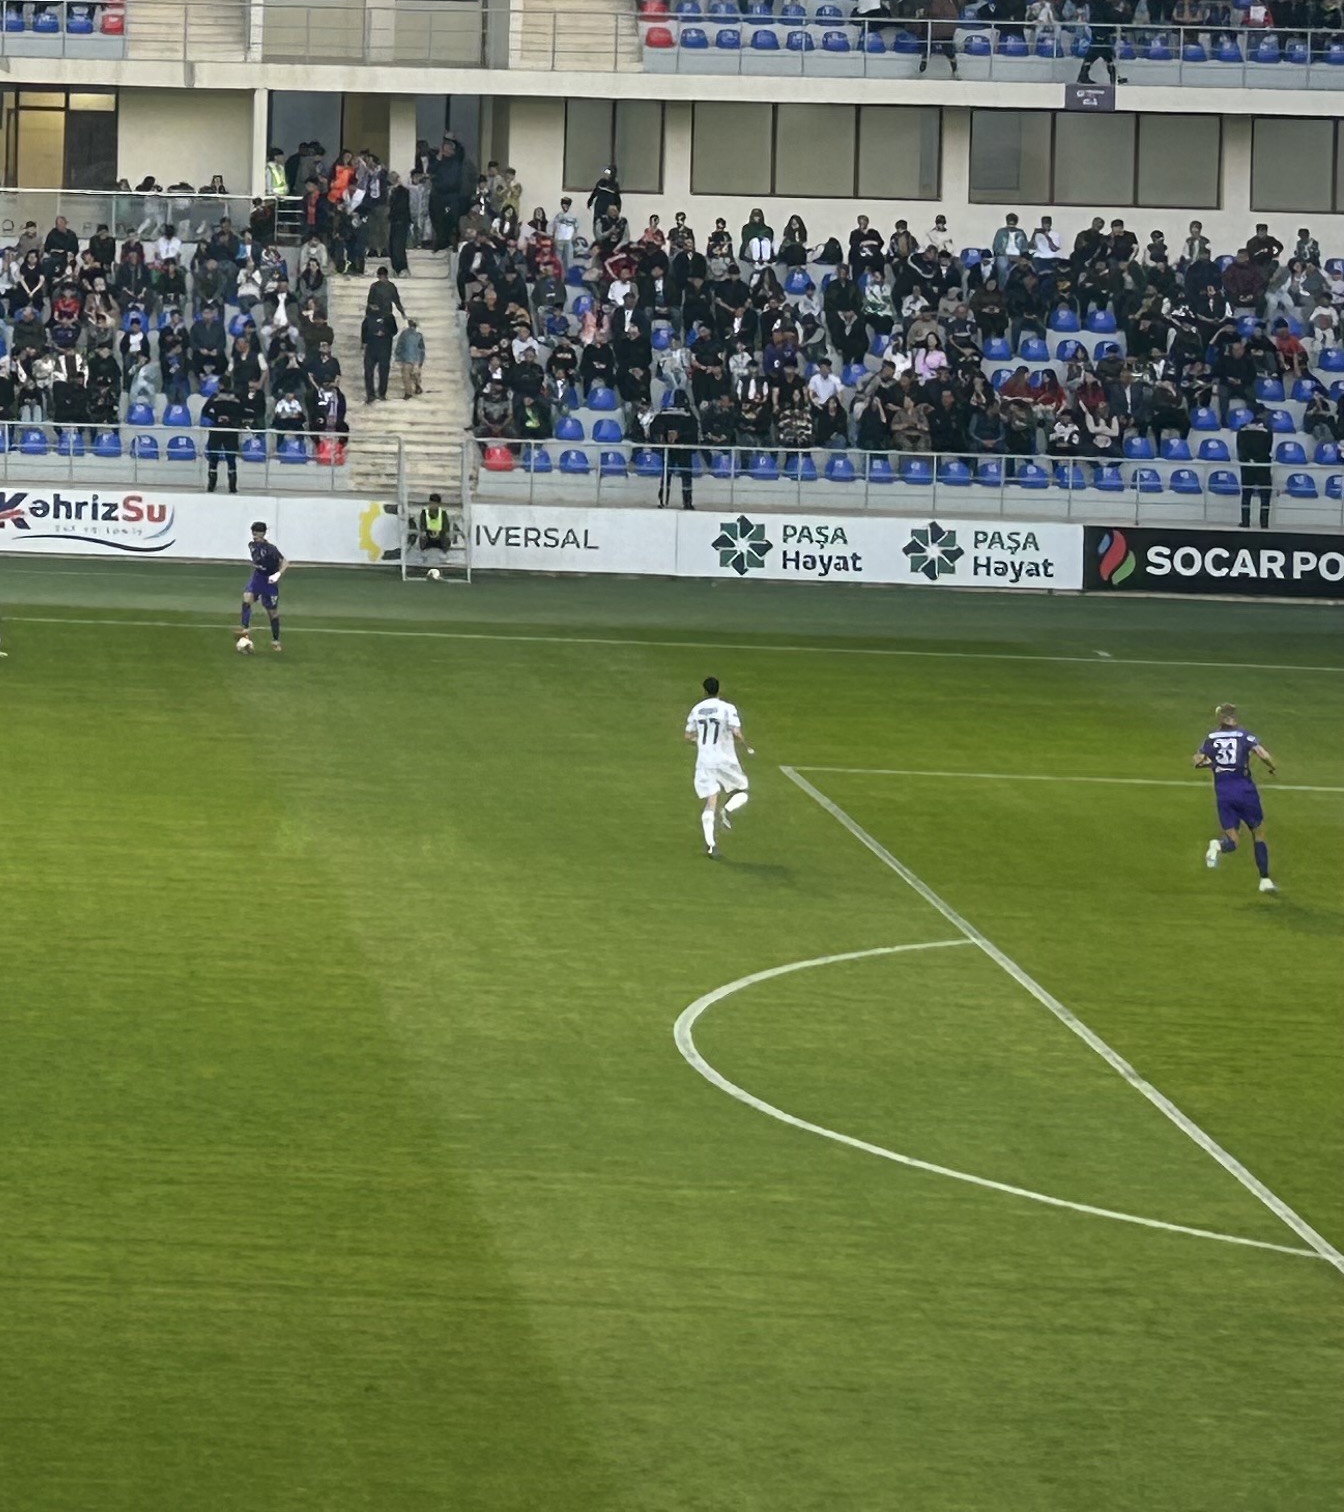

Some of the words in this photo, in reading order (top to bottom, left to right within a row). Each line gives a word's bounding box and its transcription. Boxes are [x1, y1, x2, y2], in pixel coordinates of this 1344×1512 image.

[782, 524, 849, 549] PAŞA
[973, 530, 1041, 555] PAŞA
[781, 550, 863, 577] Həyat
[972, 556, 1055, 583] Həyat
[1145, 545, 1286, 579] SOCAR
